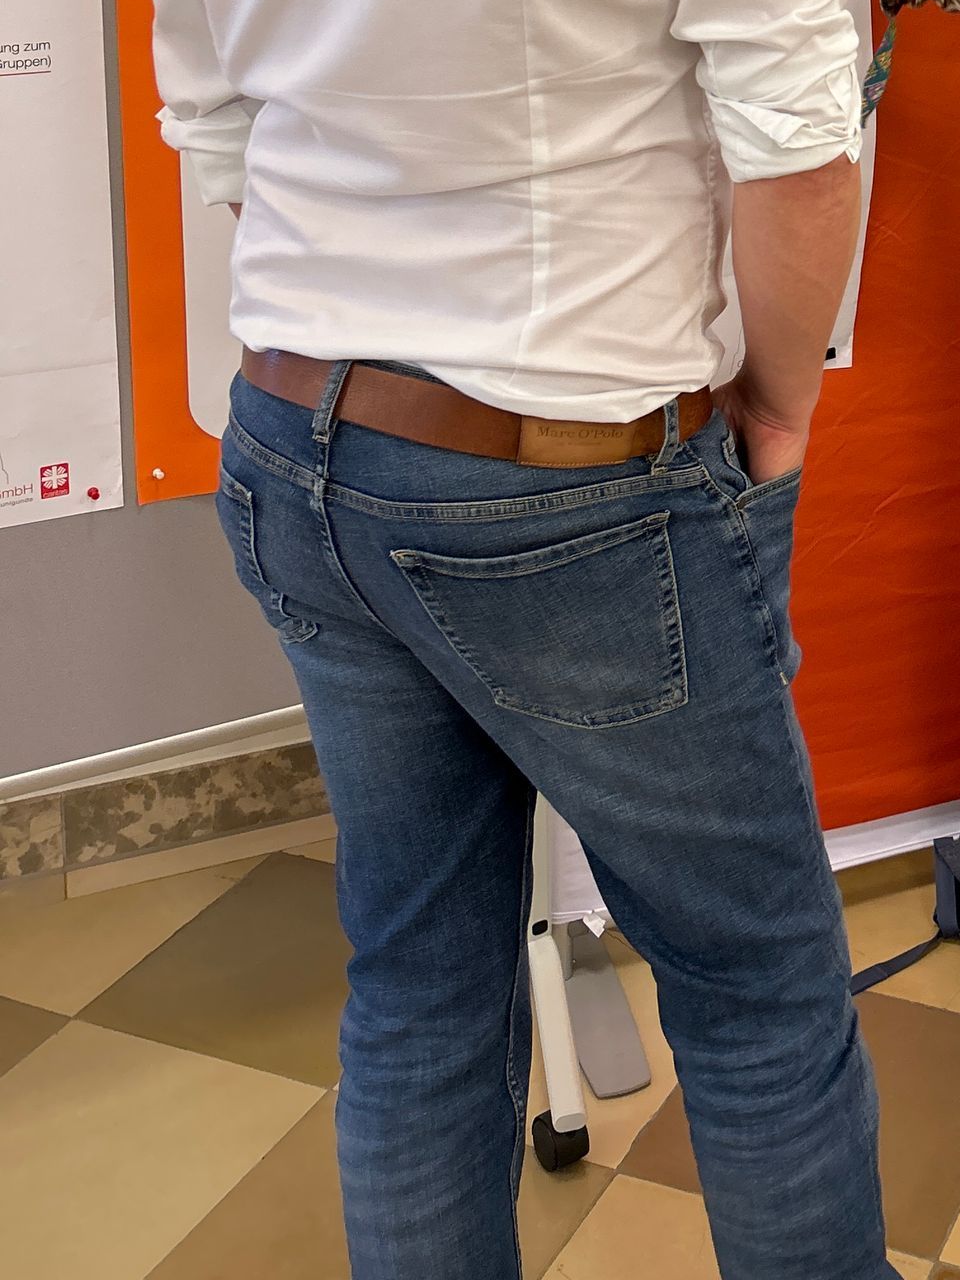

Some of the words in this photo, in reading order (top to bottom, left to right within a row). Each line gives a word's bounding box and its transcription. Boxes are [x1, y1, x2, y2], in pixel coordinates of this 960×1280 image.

[23, 41, 51, 52] zum
[536, 426, 576, 438] Marc
[0, 483, 33, 498] mbH
